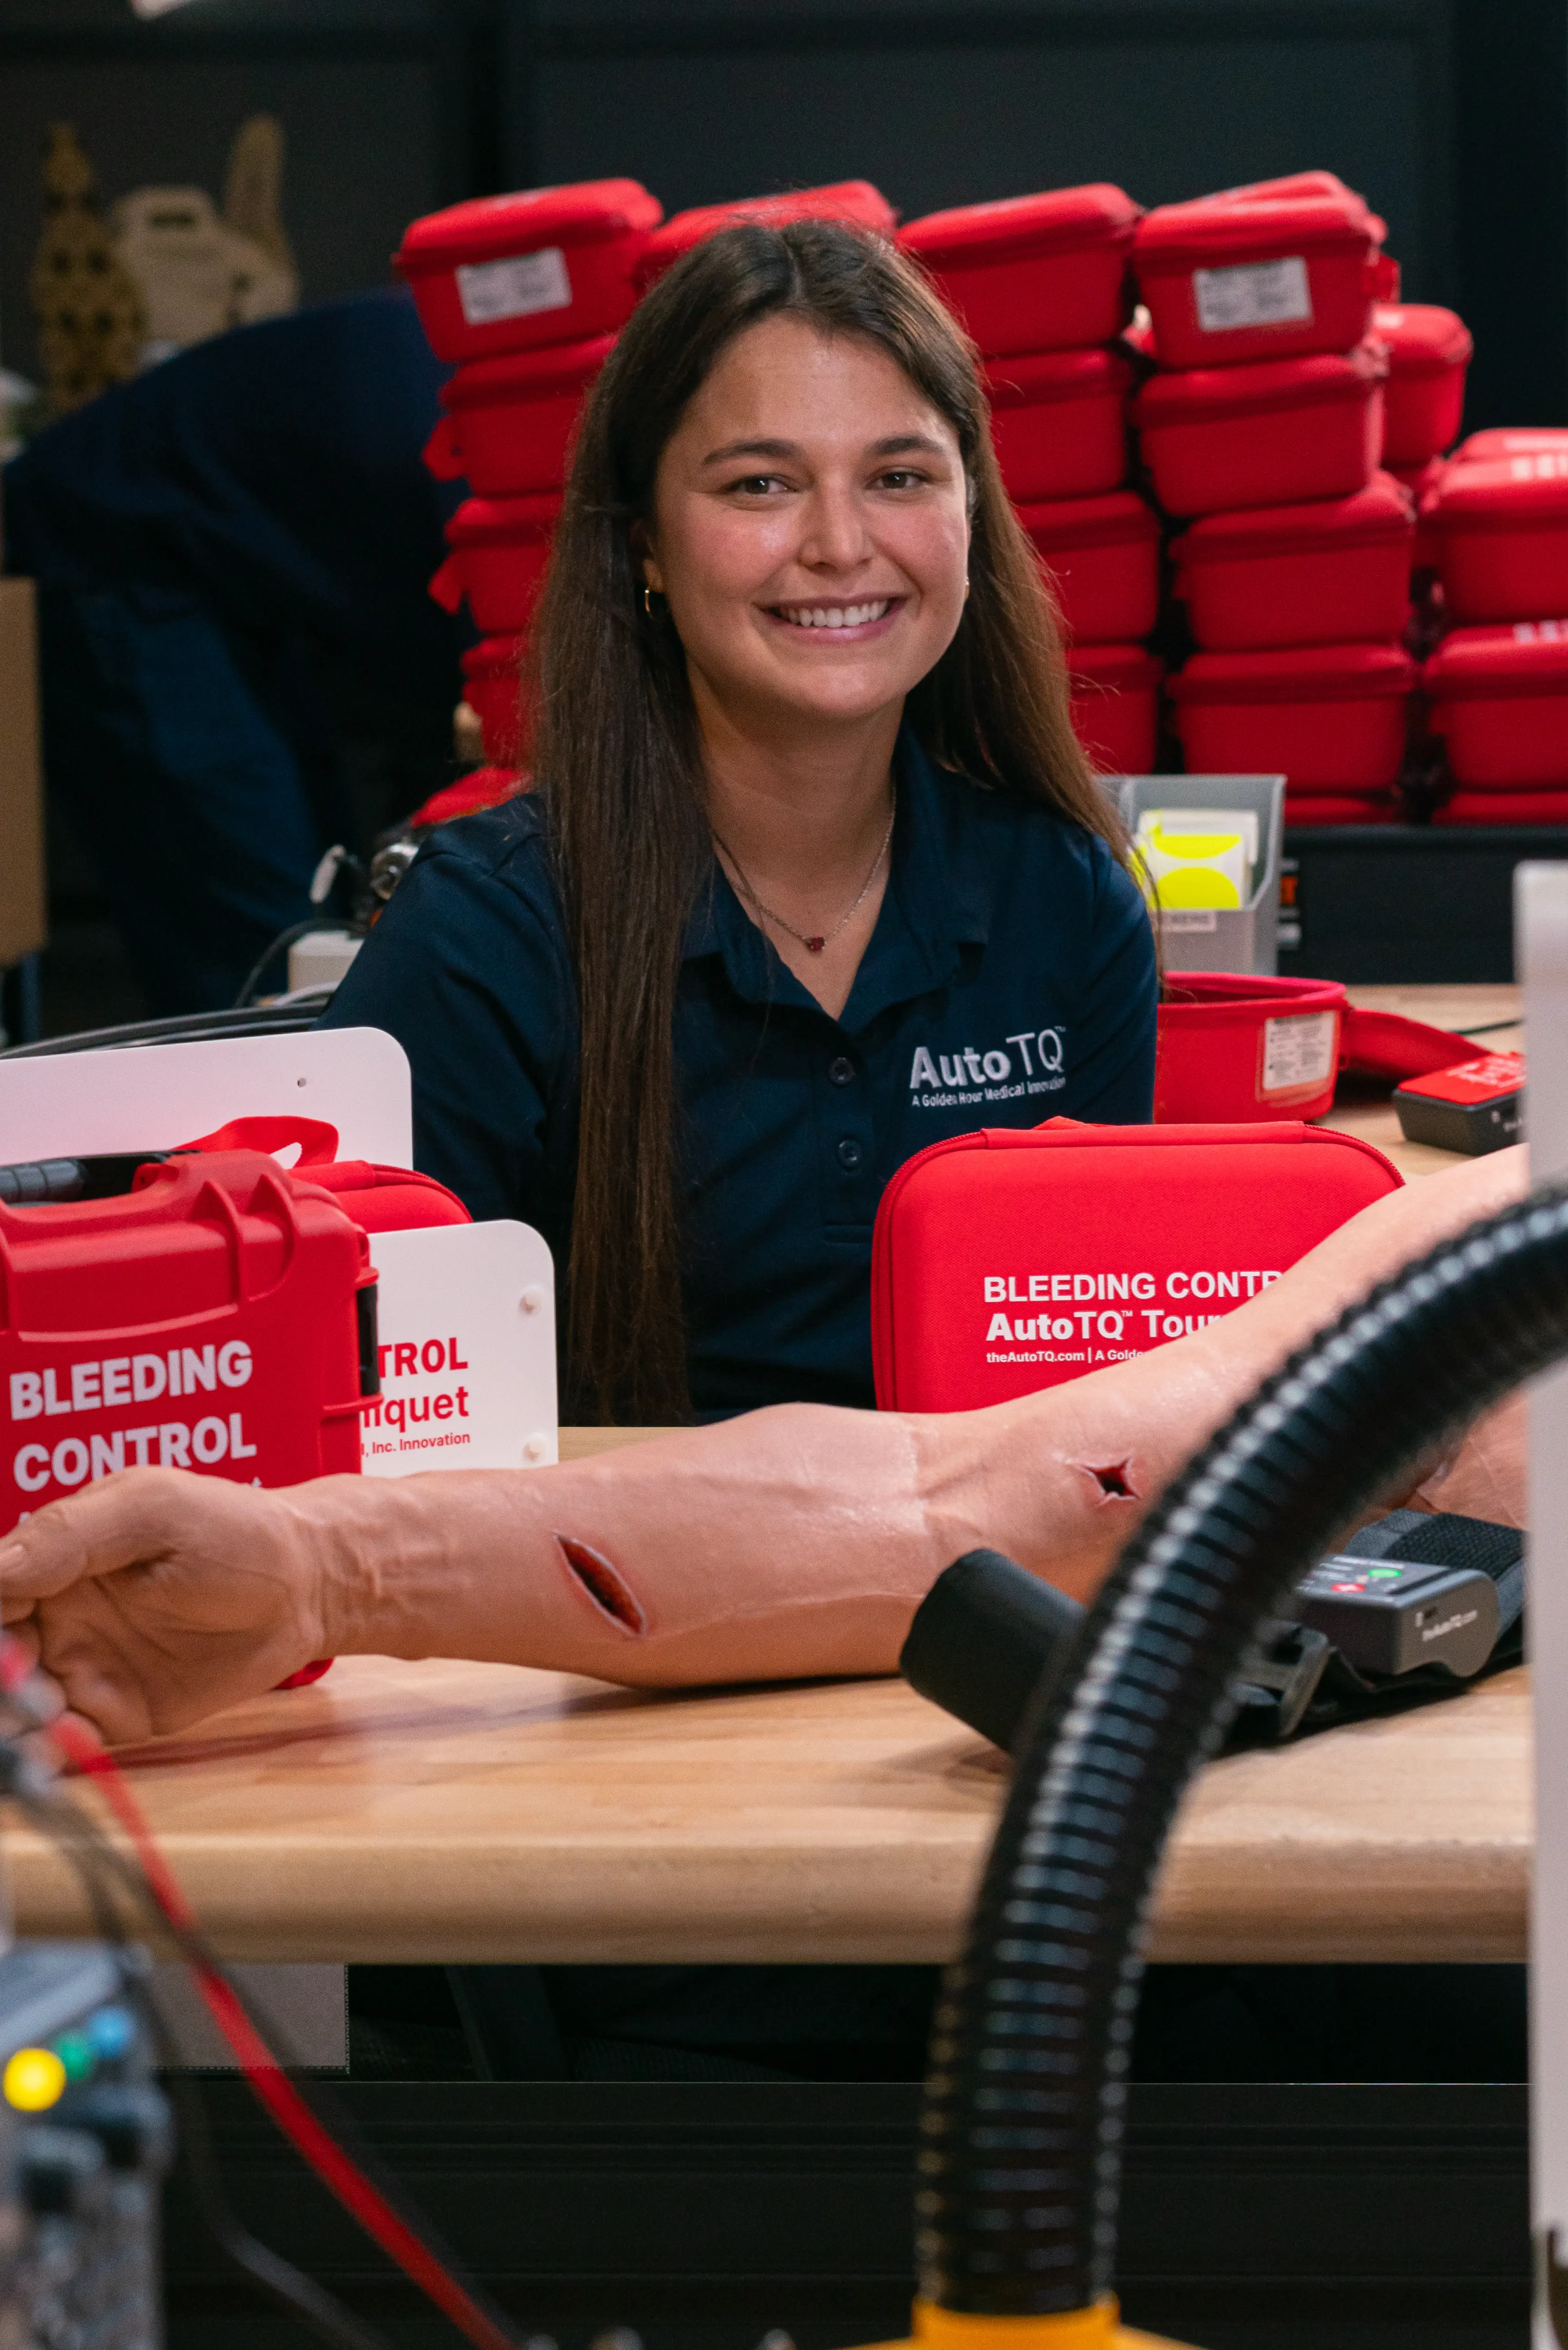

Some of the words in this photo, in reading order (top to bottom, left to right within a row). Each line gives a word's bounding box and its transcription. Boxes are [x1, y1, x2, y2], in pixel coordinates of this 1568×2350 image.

[912, 1095, 920, 1107] A
[922, 1092, 958, 1107] Golden
[959, 1091, 982, 1105] Hour
[984, 1082, 1025, 1101] Medical
[984, 1273, 1155, 1303] BLEEDING
[378, 1337, 468, 1378] TROL
[986, 1351, 1084, 1363] theAutoTQ.com
[1095, 1350, 1104, 1361] A
[9, 1340, 253, 1421] BLEEDING
[13, 1412, 257, 1492] CONTROL
[372, 1442, 396, 1454] Inc.
[400, 1432, 470, 1451] Innovation
